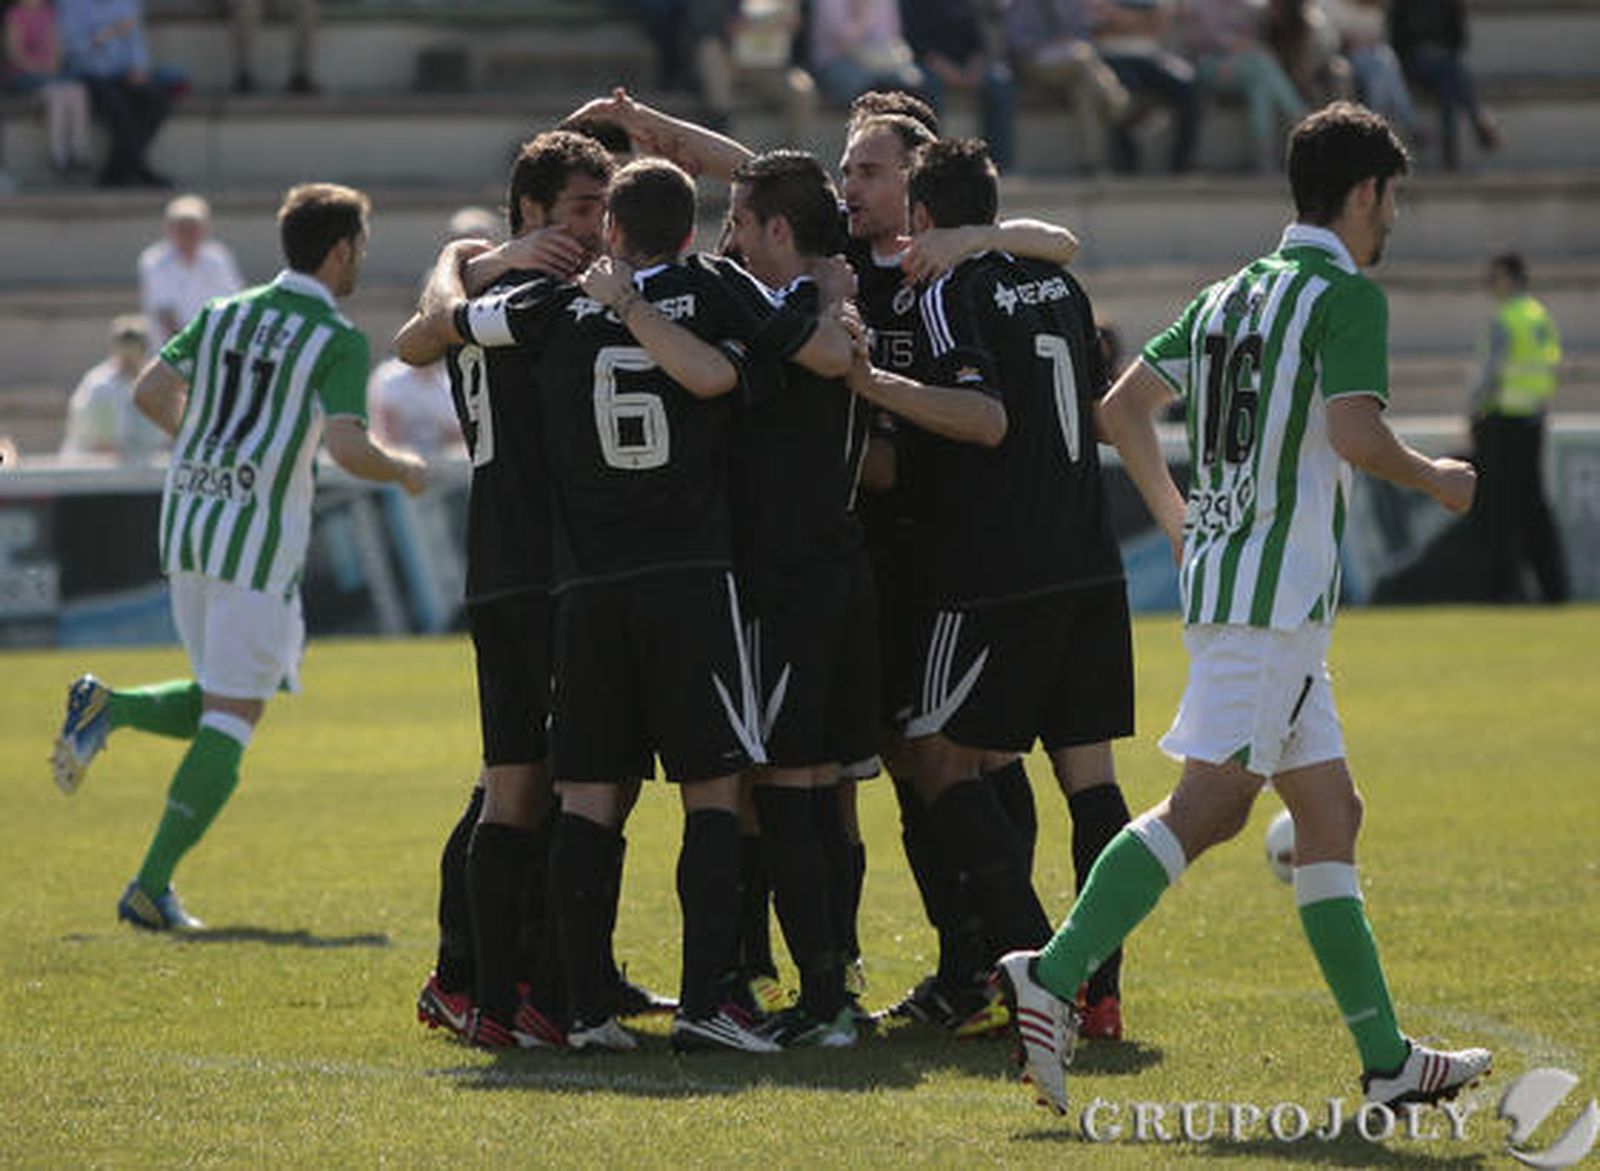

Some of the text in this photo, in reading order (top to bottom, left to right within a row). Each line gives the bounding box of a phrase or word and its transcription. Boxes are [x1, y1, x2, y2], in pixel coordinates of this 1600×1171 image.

[206, 350, 277, 449] 11
[458, 344, 495, 467] 9
[594, 346, 670, 469] 6
[1203, 333, 1262, 465] 16
